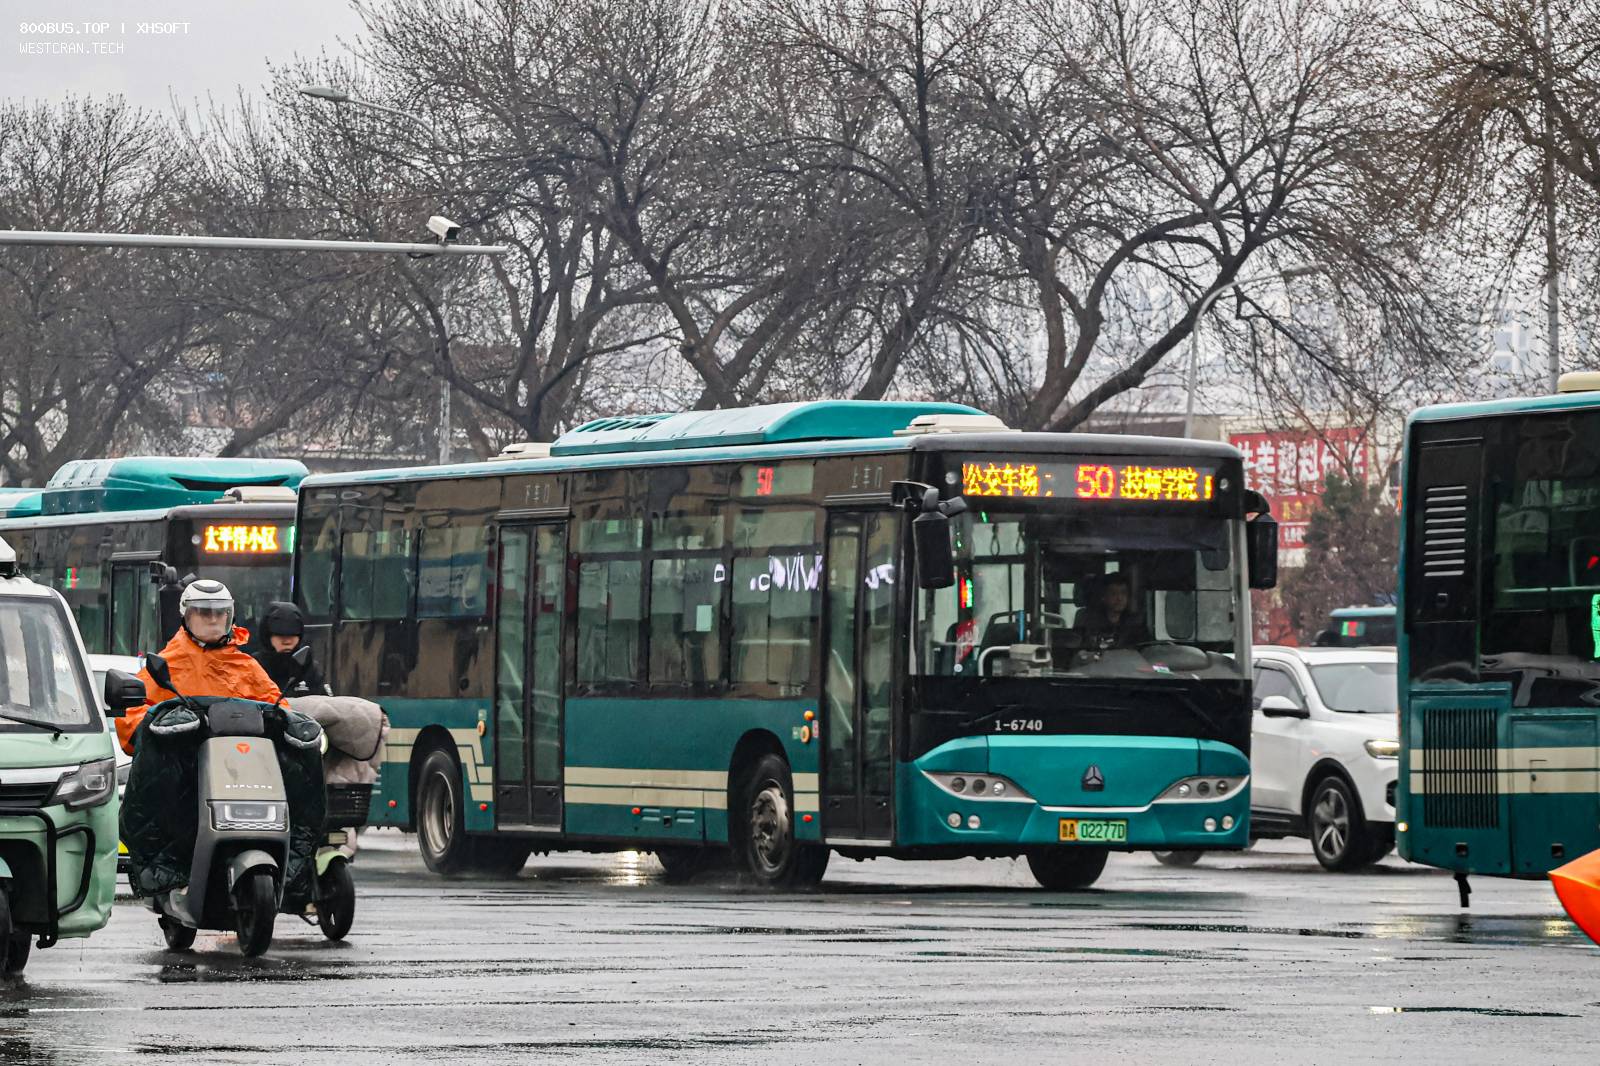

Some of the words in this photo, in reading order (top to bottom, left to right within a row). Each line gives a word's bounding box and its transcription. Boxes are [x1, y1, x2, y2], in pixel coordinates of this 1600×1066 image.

[756, 466, 774, 496] 50
[1077, 463, 1116, 499] 50
[994, 719, 1043, 731] 1-6740
